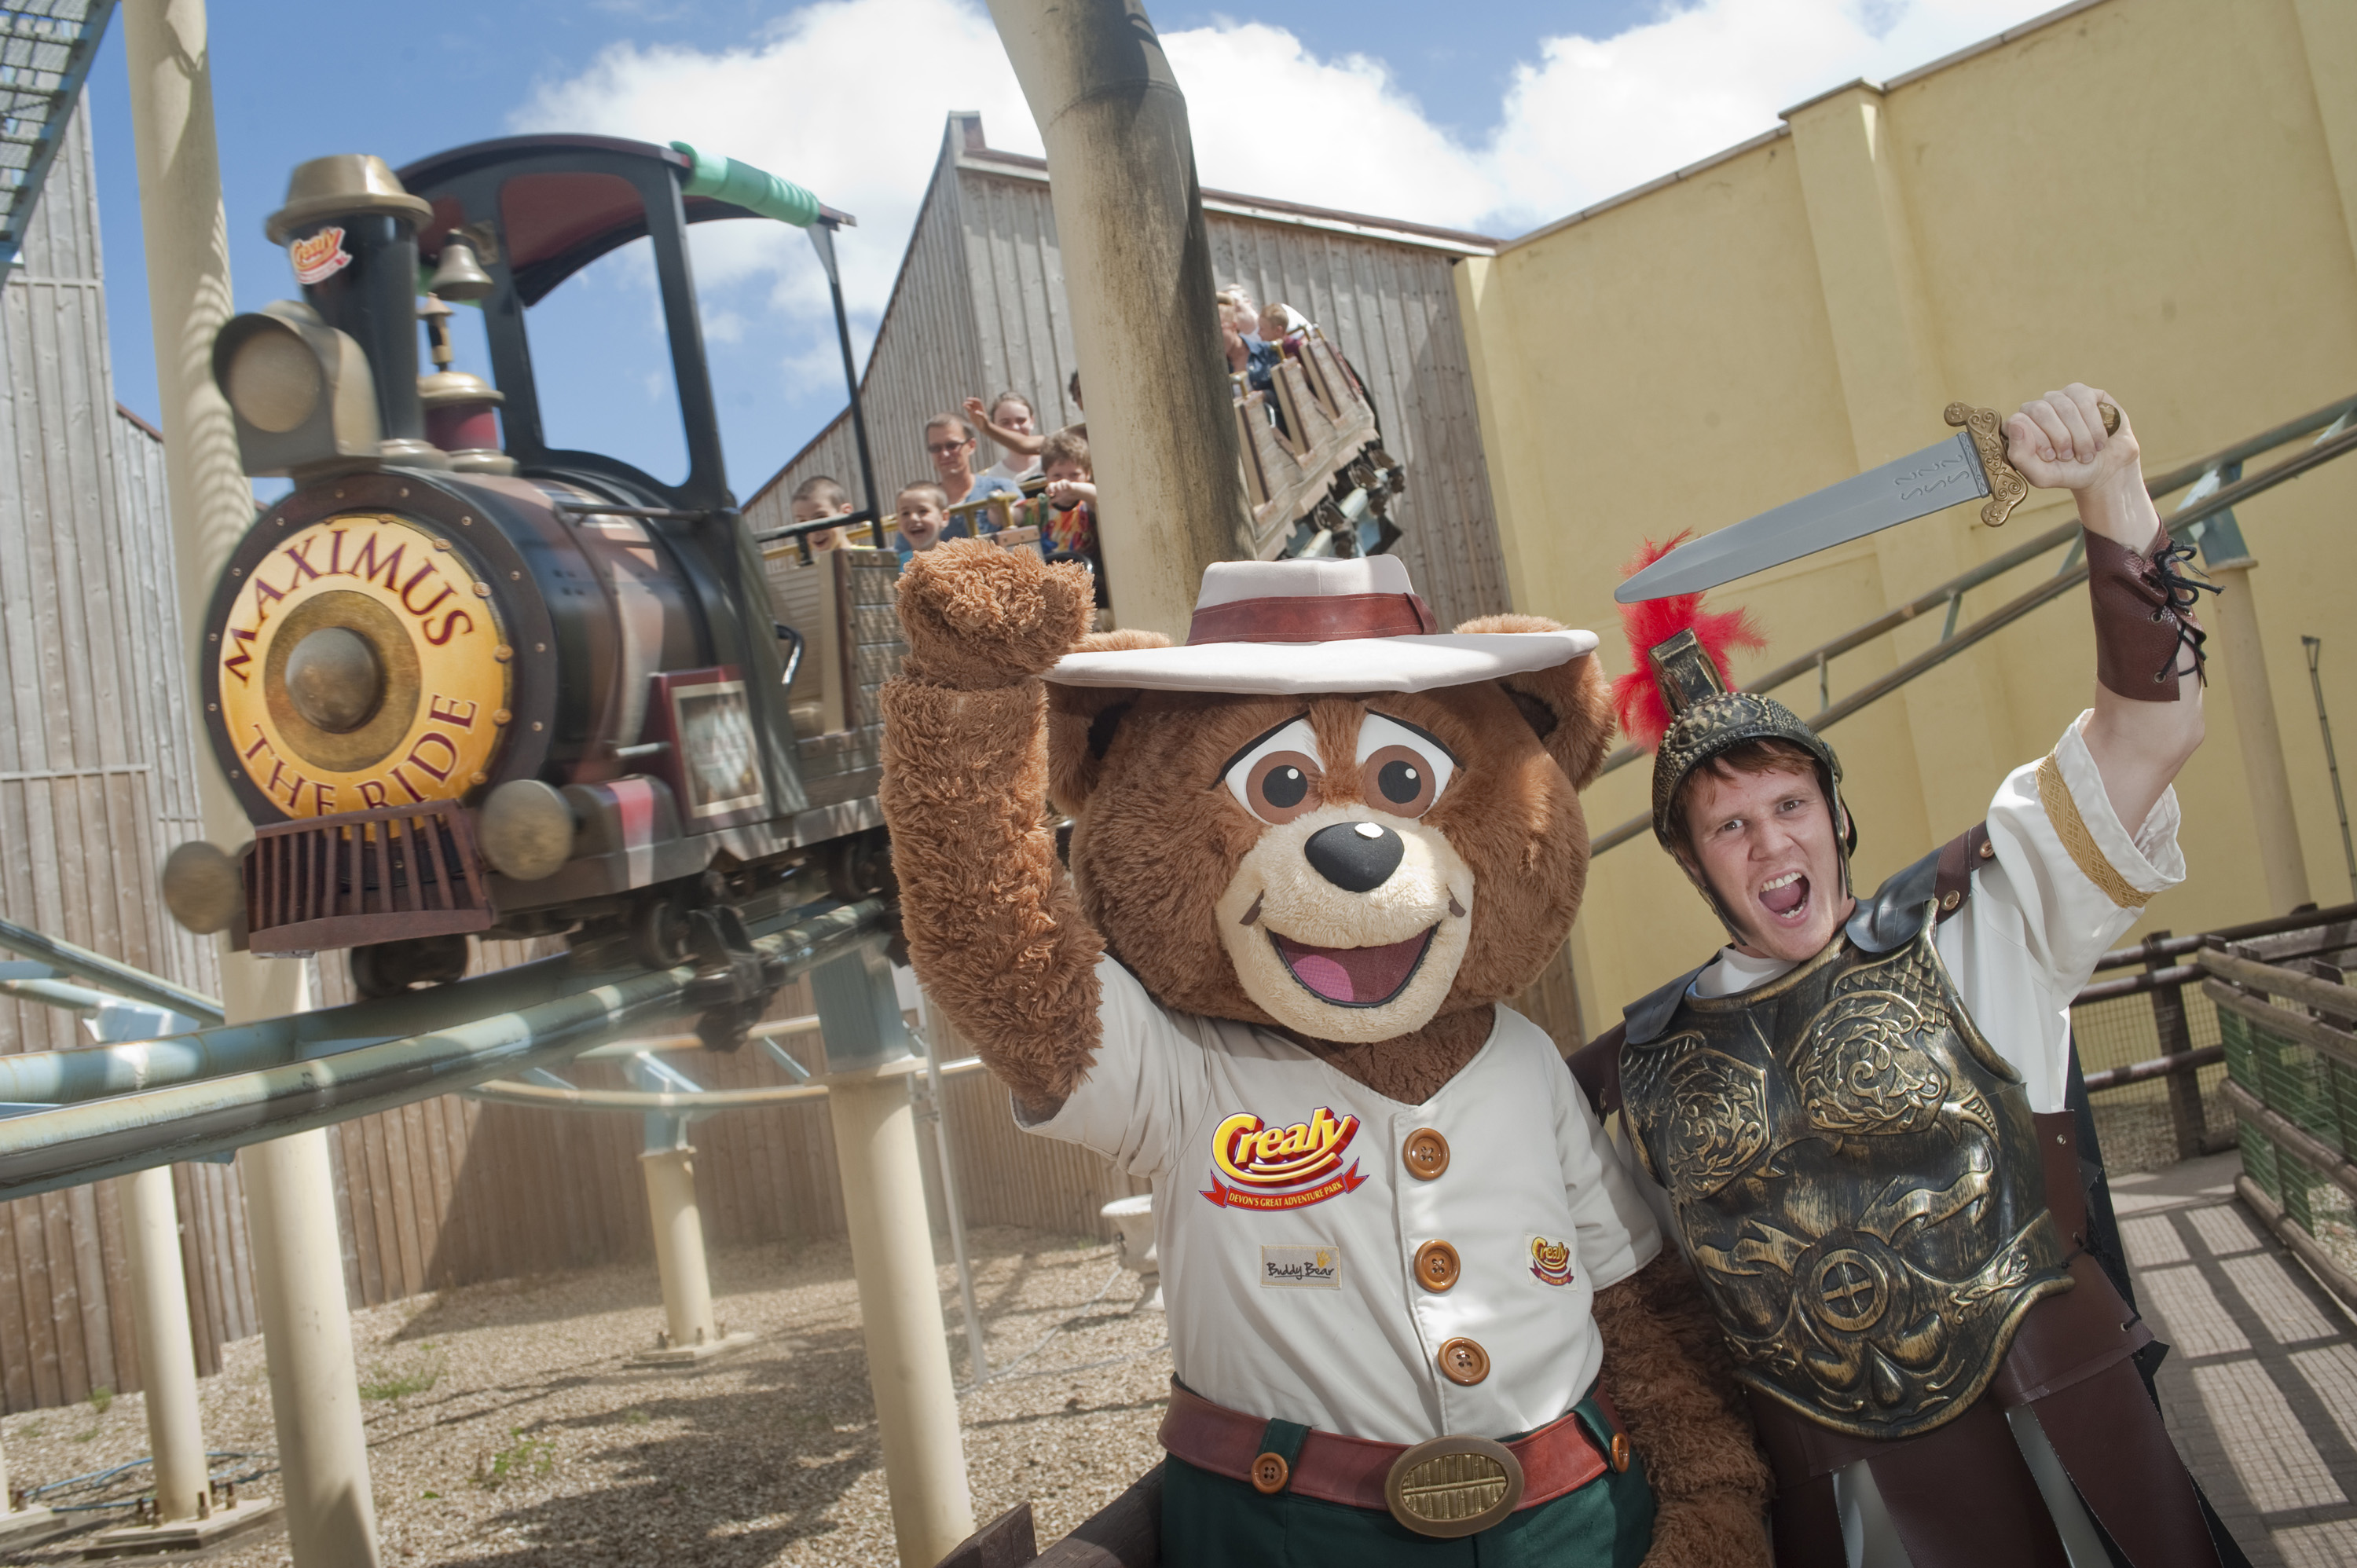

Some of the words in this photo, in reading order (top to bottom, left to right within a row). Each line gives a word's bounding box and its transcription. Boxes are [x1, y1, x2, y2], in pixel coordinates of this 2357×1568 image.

[224, 528, 475, 683] MAXIMUS
[244, 723, 337, 816] THE
[357, 693, 478, 810] RIDE
[1211, 1106, 1361, 1189] Crealy
[1229, 1192, 1259, 1207] DEVON'S
[1260, 1198, 1282, 1207] GREAT
[1284, 1190, 1325, 1206] ADVENTURE
[1325, 1181, 1343, 1196] PARK
[1266, 1262, 1303, 1280] Buddy
[1303, 1262, 1334, 1277] Bear
[1531, 1236, 1570, 1274] Crealy
